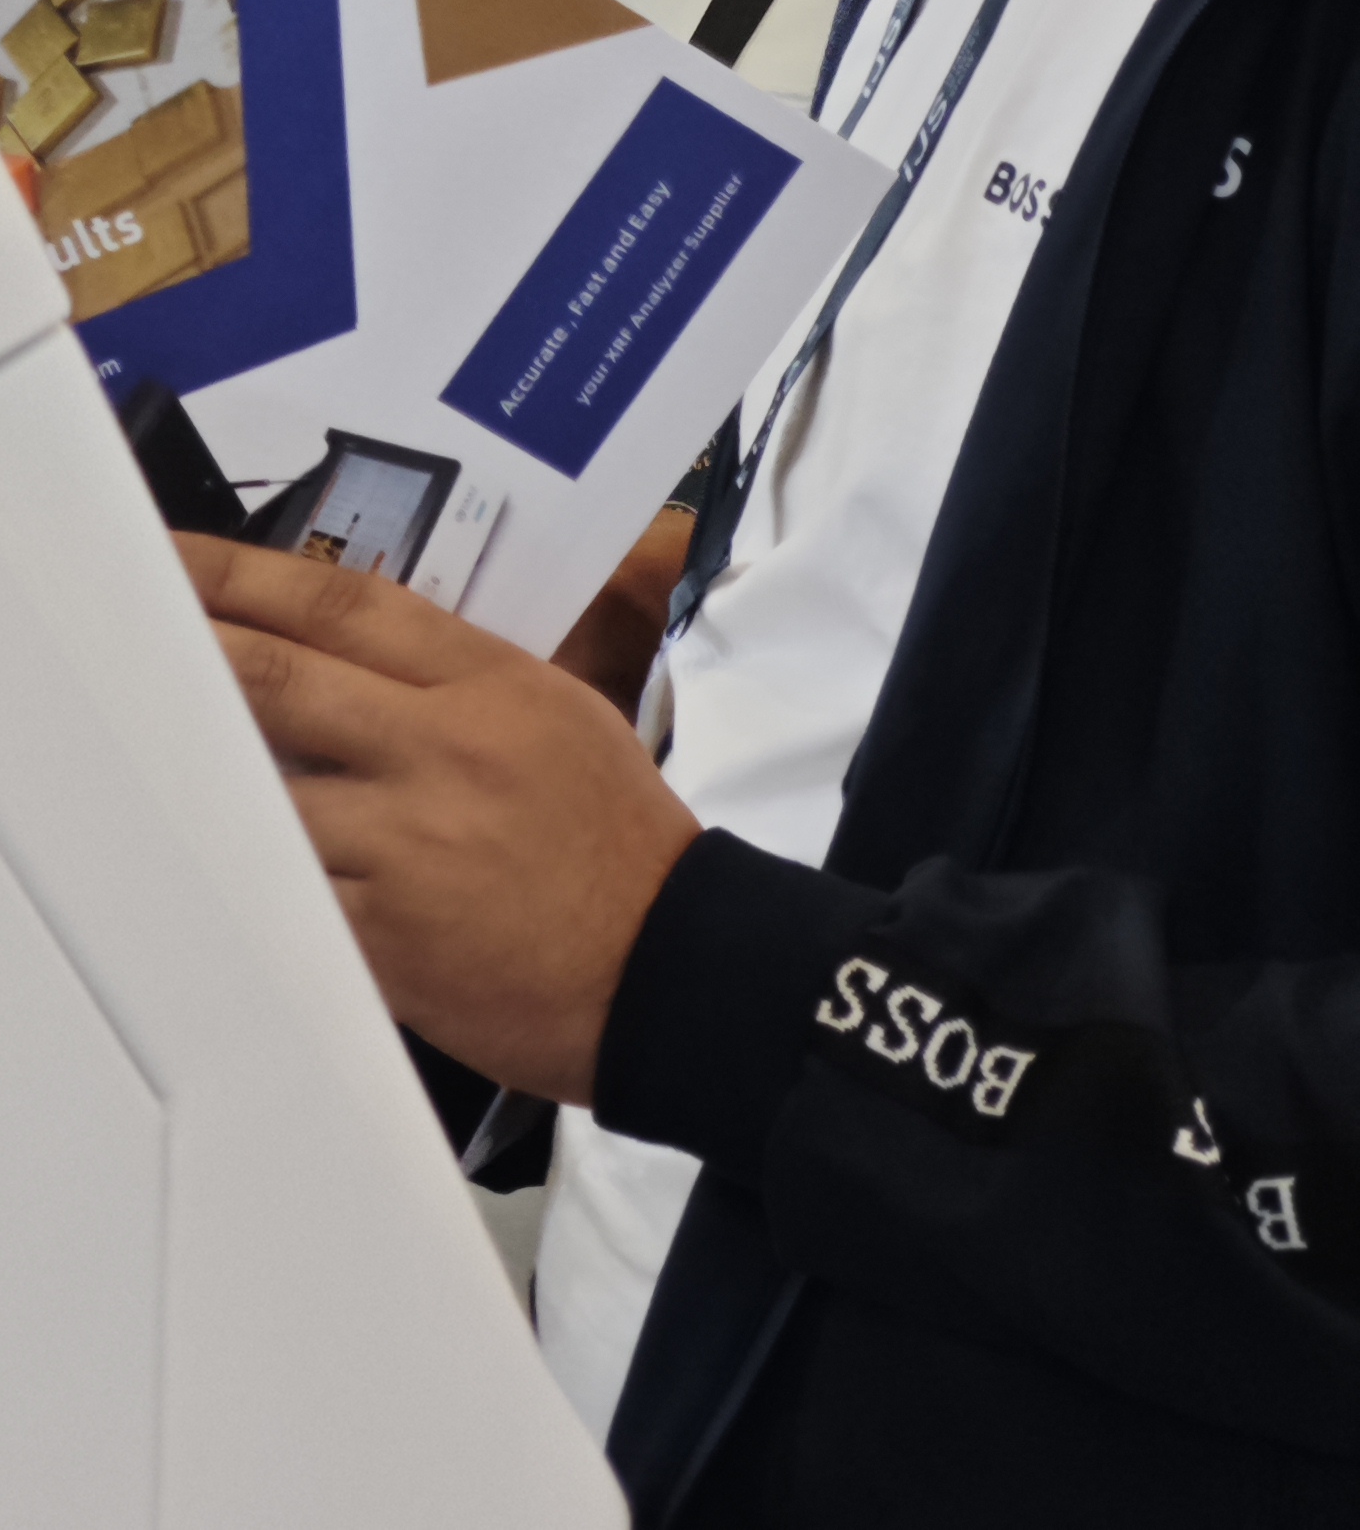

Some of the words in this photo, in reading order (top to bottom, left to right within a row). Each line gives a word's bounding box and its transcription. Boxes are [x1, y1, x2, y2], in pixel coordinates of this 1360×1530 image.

[499, 326, 569, 417] Accurate
[567, 271, 608, 316] Fast
[602, 228, 637, 274] and
[627, 180, 672, 231] Easy
[576, 362, 609, 406] your
[604, 327, 633, 364] XRF
[629, 250, 690, 330] Analyzer
[683, 174, 742, 250] Supplier
[816, 957, 1036, 1117] BOSS
